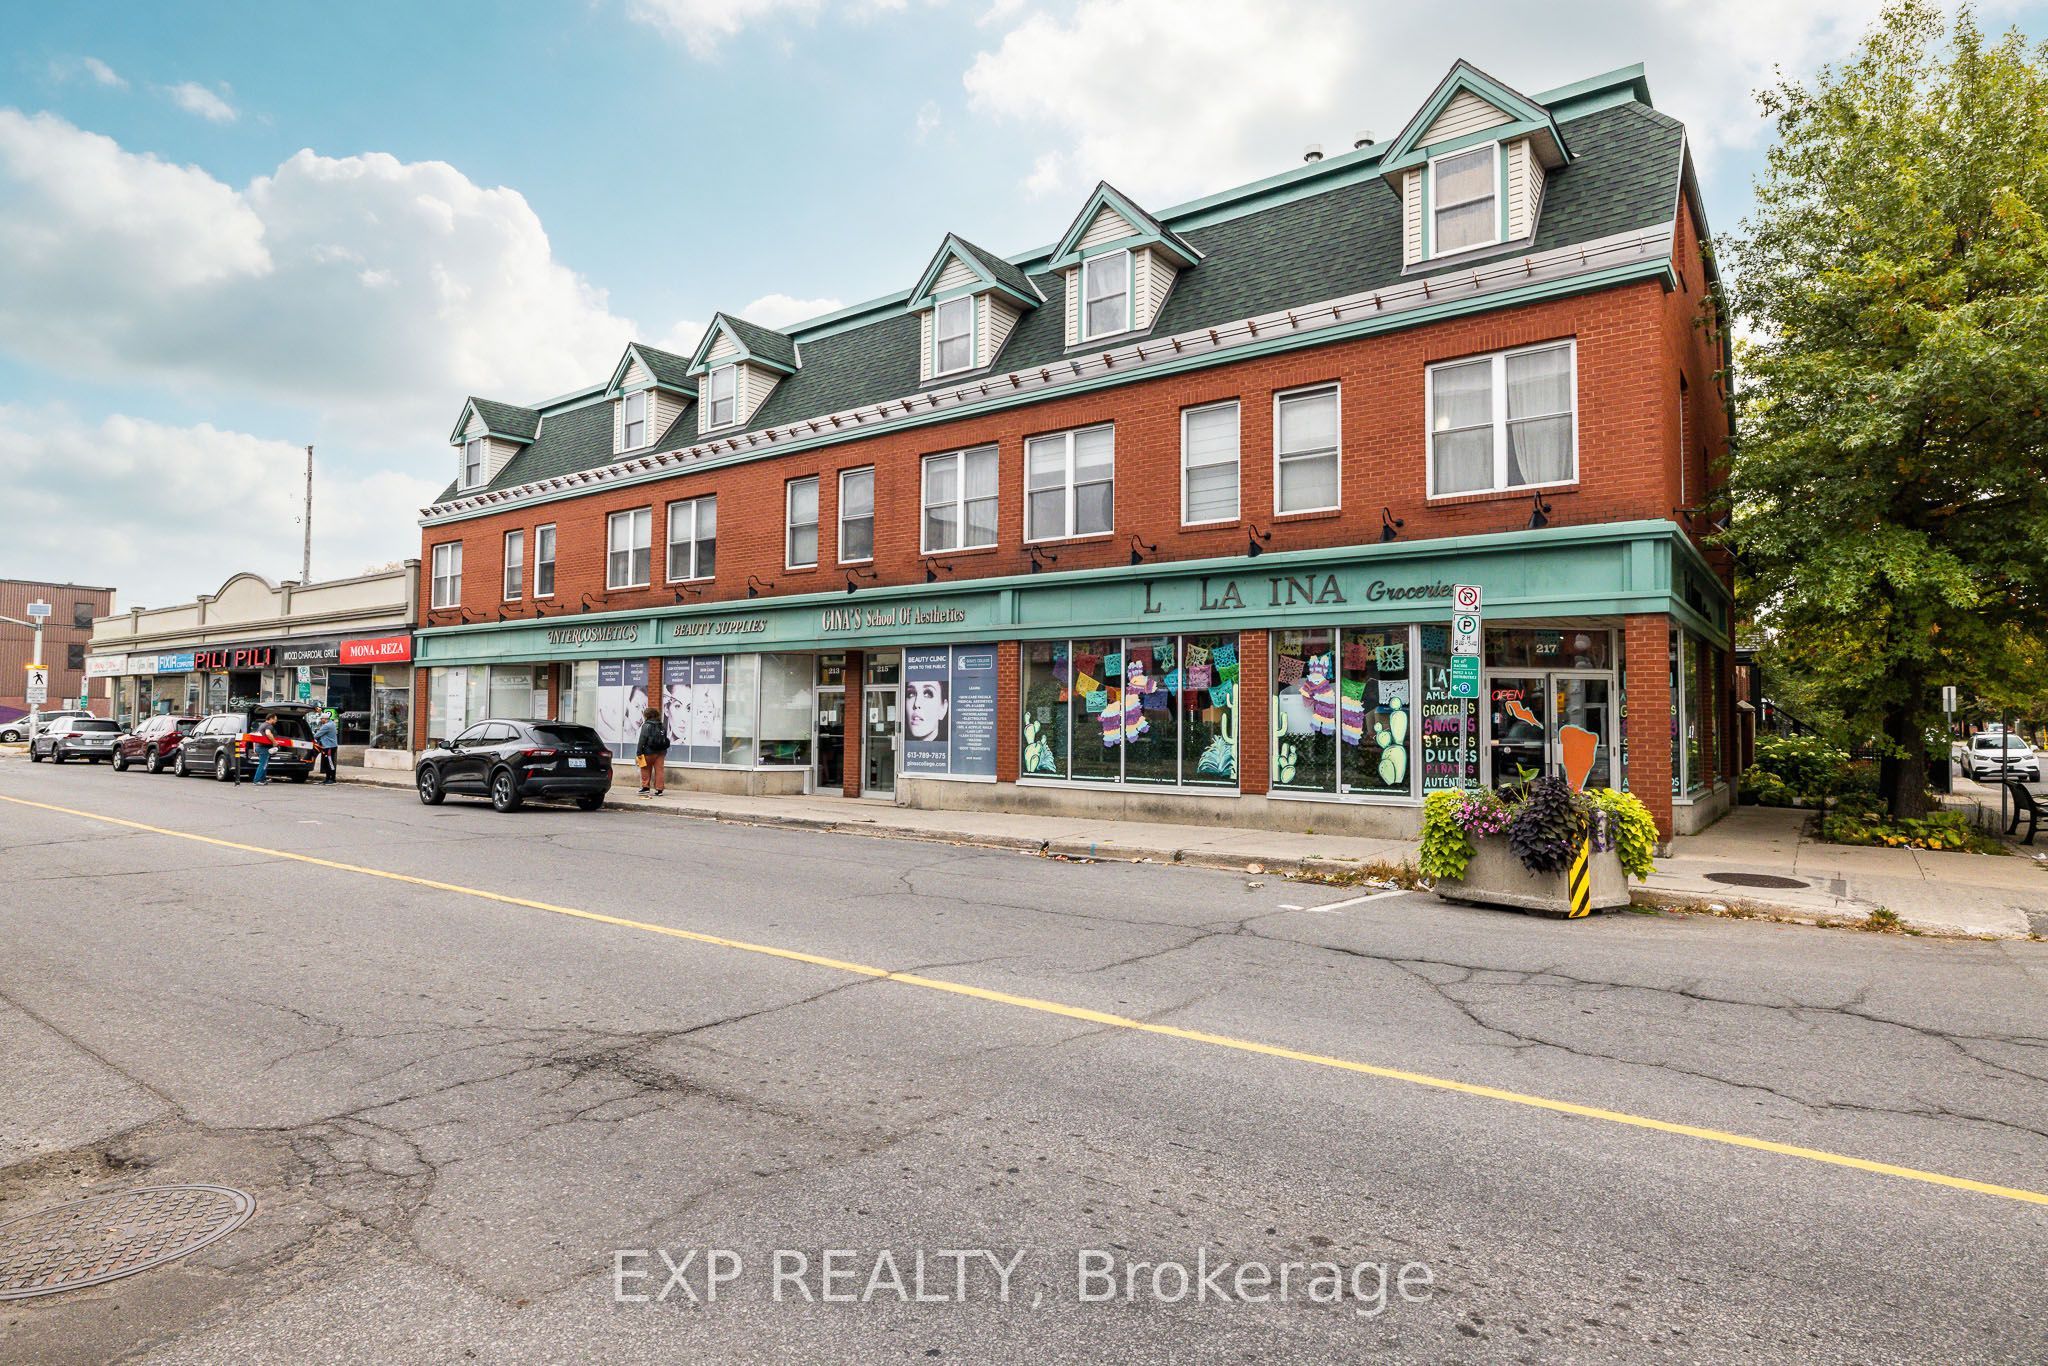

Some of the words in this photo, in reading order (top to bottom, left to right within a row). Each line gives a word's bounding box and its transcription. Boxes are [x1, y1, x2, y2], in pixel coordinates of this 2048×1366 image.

[1144, 580, 1161, 614] L
[1200, 577, 1246, 610] LA
[1268, 574, 1348, 606] INA
[822, 607, 862, 631] GINA'S
[866, 607, 895, 627] School
[900, 607, 911, 625] Of
[915, 605, 965, 624] Aesthetics
[673, 622, 714, 637] BEAUTY
[715, 619, 767, 635] SUPPLIES
[548, 624, 638, 647] INTERCOSMETICS
[284, 651, 297, 660] WOOD
[298, 650, 323, 659] CHARCOAL
[324, 649, 337, 658] GRILL
[350, 645, 374, 656] MONA
[381, 642, 403, 654] REZA
[1536, 644, 1557, 653] 217
[195, 652, 226, 668] PILI
[235, 648, 270, 667] PILI
[1491, 689, 1525, 701] OPEN
[1423, 703, 1475, 717] GROCERS
[1425, 737, 1476, 747] SPICS
[1426, 763, 1474, 774] PIÑATS
[1424, 775, 1477, 787] AUTÉNTCOS
